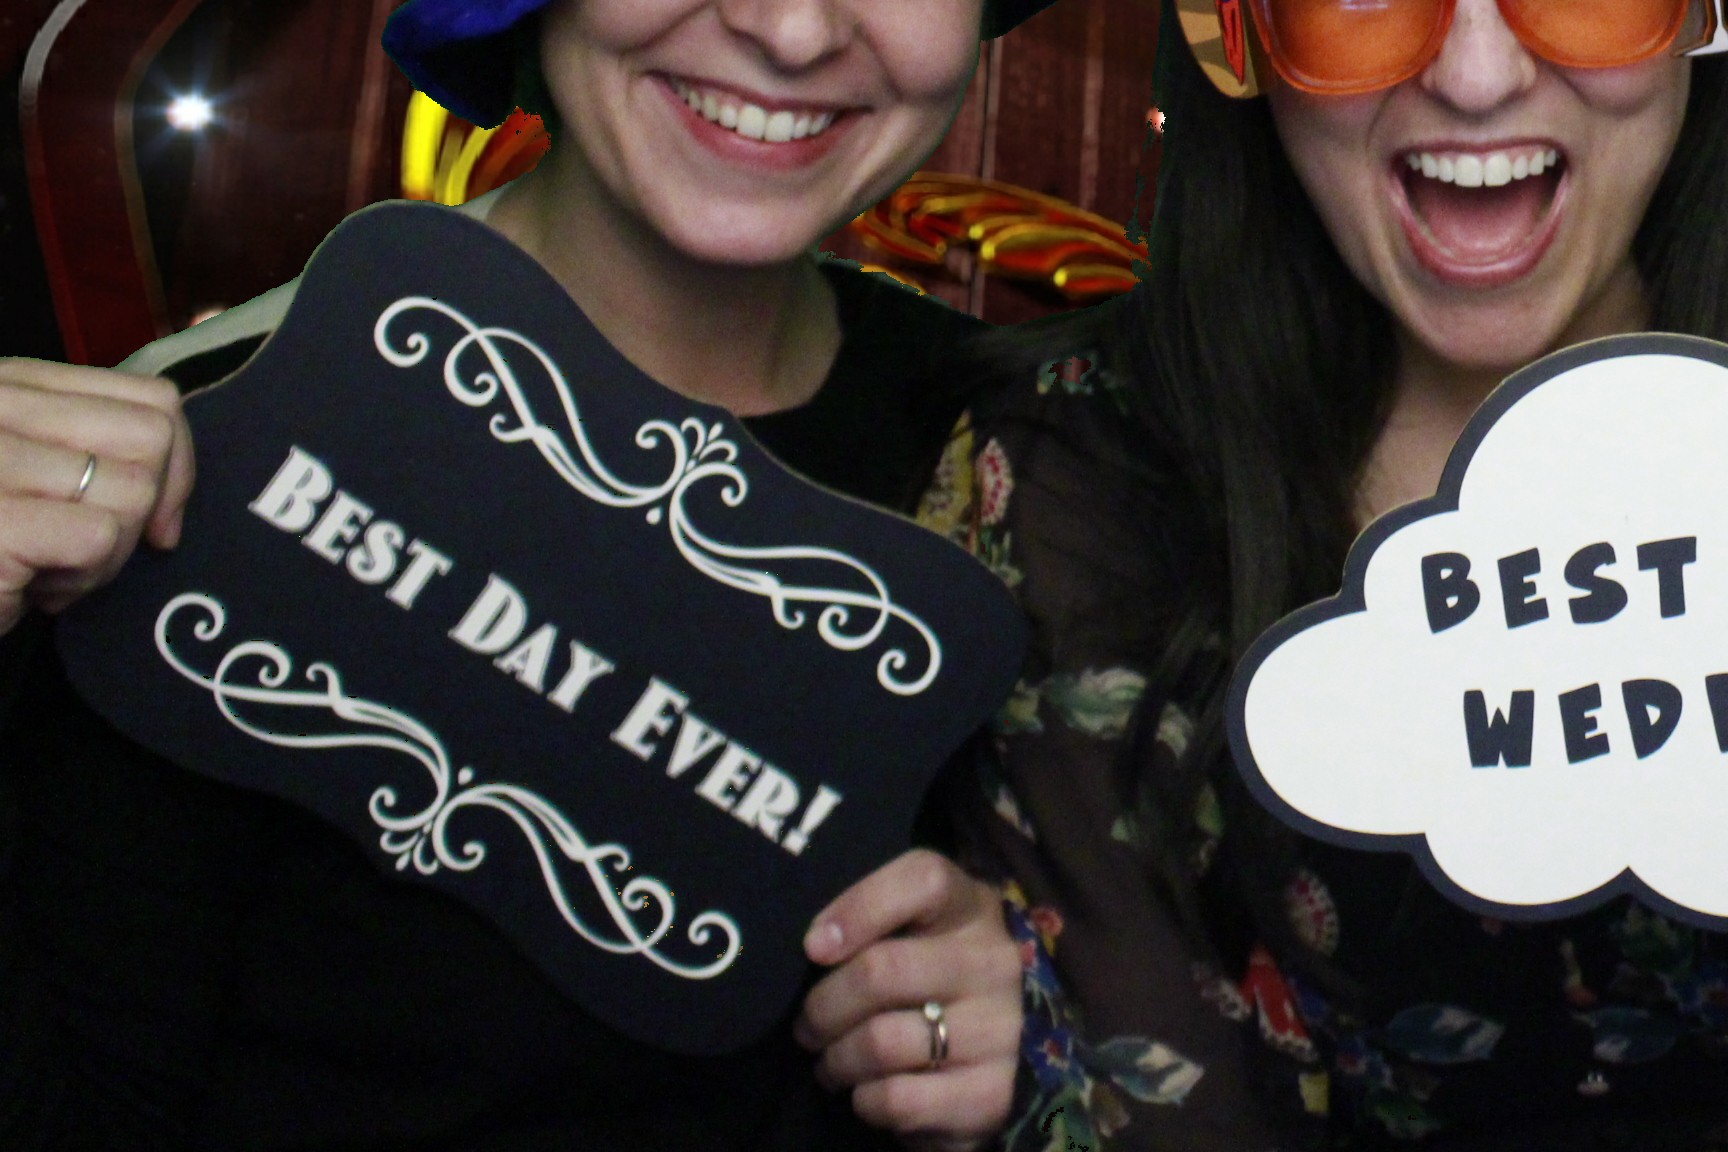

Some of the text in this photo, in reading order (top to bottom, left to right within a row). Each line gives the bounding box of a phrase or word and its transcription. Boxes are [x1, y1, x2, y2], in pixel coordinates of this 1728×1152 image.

[247, 445, 841, 856] BEST DAY EVER!
[1421, 536, 1697, 634] BEST
